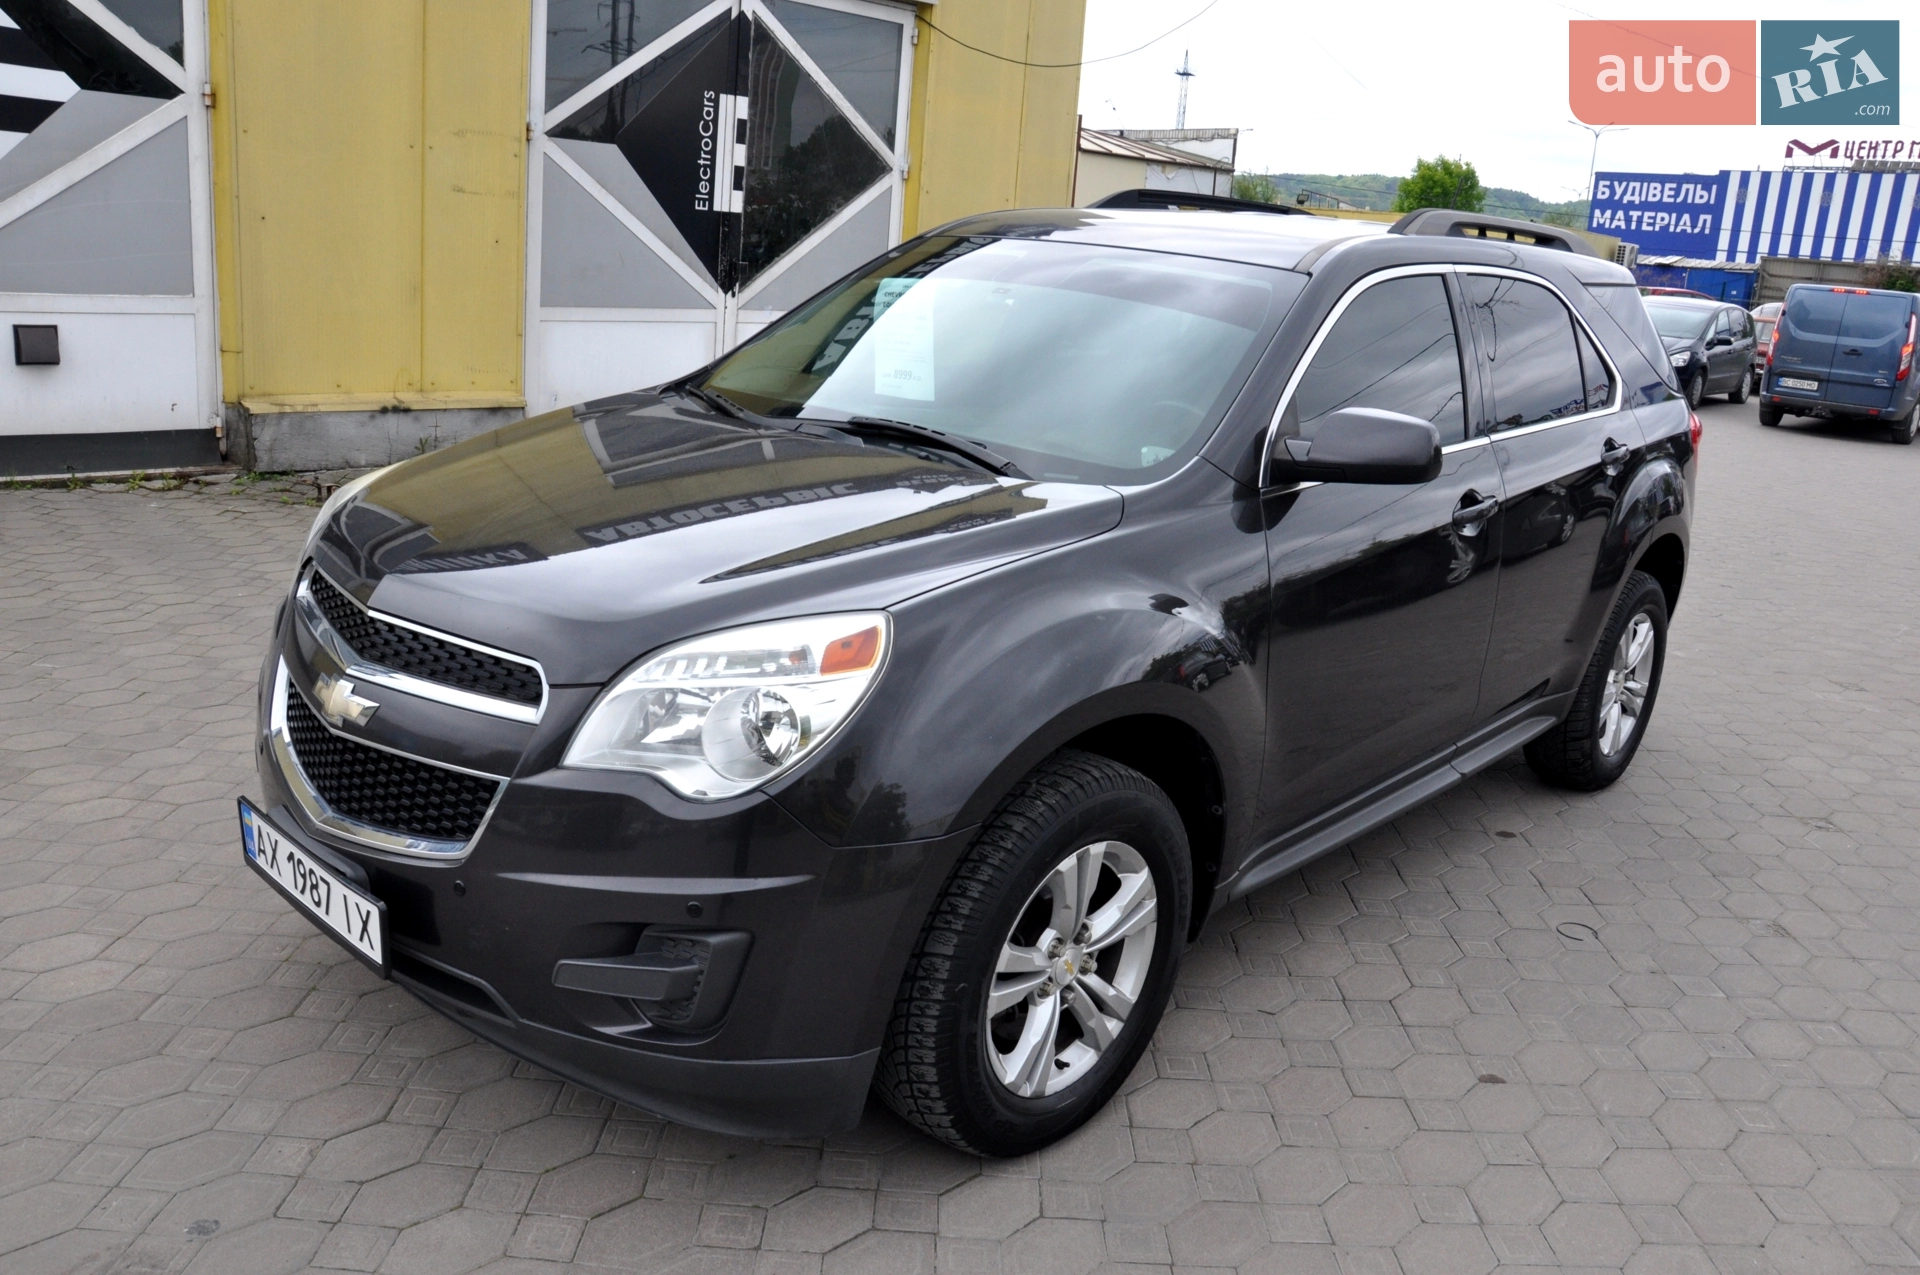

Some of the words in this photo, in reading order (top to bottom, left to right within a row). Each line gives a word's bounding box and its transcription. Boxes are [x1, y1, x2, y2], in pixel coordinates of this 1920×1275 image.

[695, 90, 715, 211] ElectroCars
[1843, 140, 1905, 161] ЦЕНТР
[1592, 208, 1713, 235] МАТЕРІАЛ
[893, 369, 913, 380] 8999
[1782, 378, 1791, 386] BC
[1791, 379, 1806, 387] 0250
[257, 824, 282, 877] AX
[287, 851, 331, 916] 1987
[343, 893, 375, 951] IX
